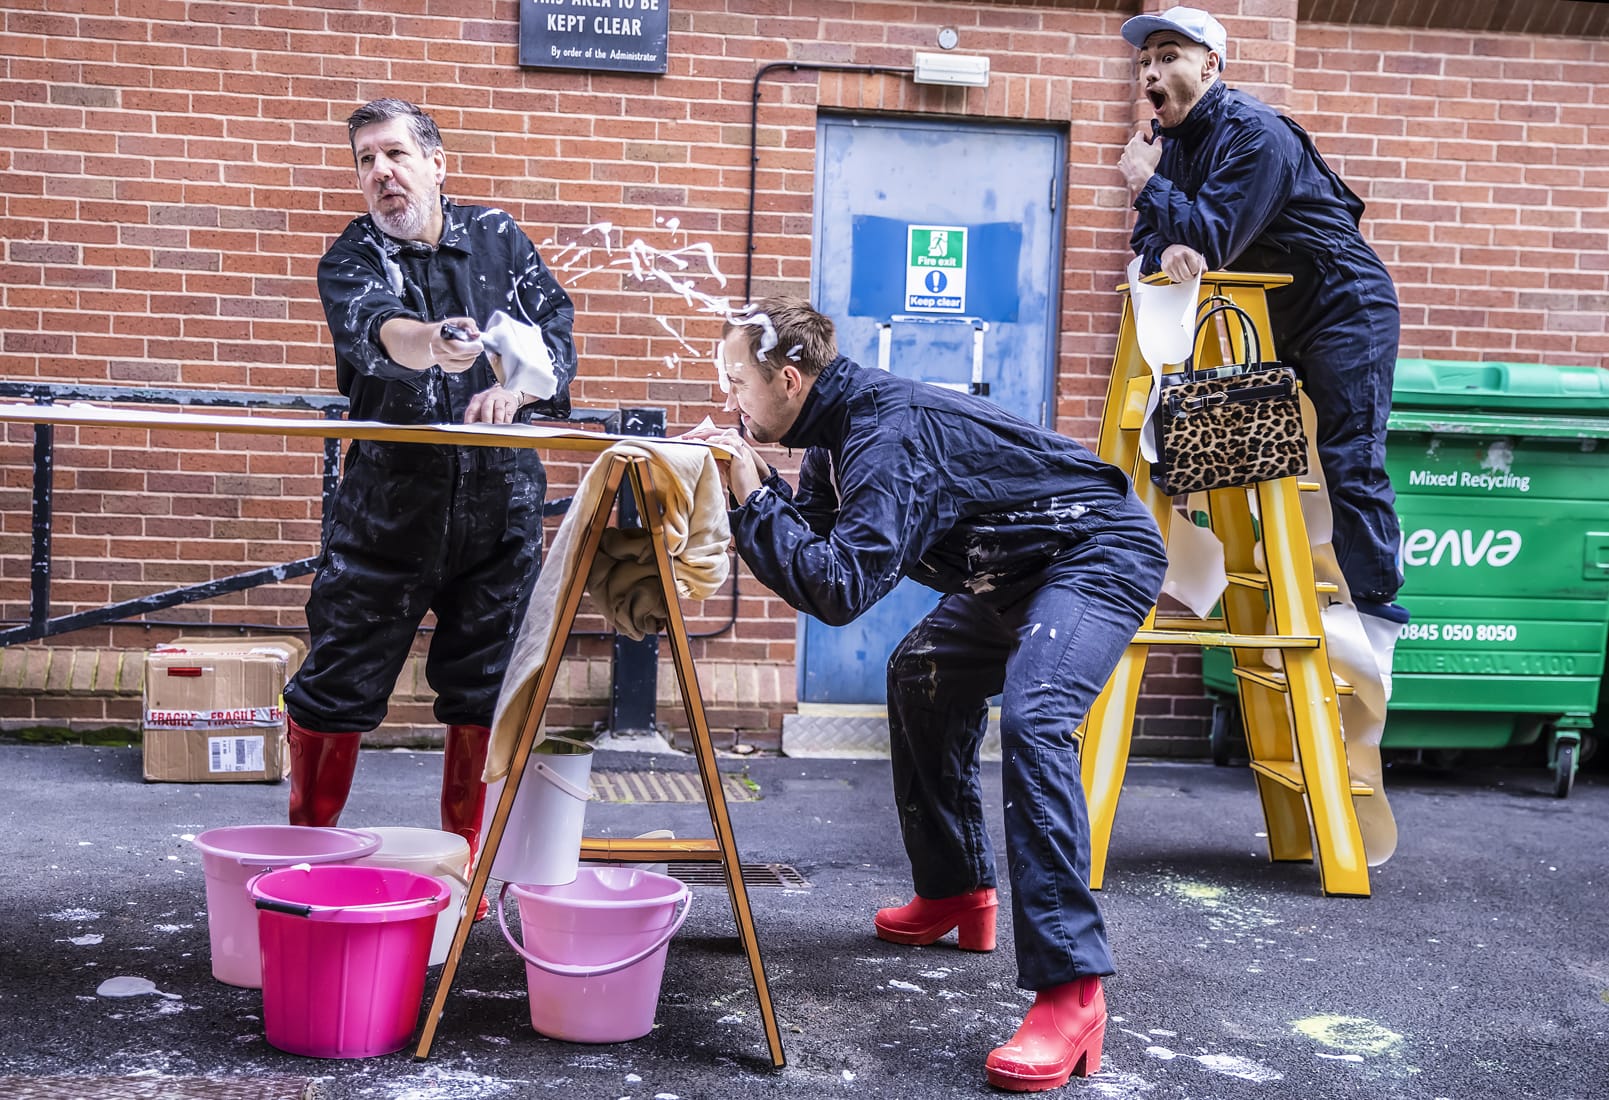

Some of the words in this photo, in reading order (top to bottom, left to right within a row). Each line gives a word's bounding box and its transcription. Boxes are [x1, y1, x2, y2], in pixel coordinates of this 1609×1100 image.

[548, 14, 586, 32] KEPT
[594, 17, 642, 36] CLEAR
[551, 45, 561, 58] By
[563, 47, 582, 58] order
[585, 48, 593, 58] of
[595, 49, 606, 59] the
[610, 49, 657, 61] Administrator
[917, 256, 937, 266] Fire
[938, 257, 957, 267] exit
[910, 296, 935, 308] Keep
[936, 297, 960, 307] clear
[1409, 470, 1458, 487] Mixed
[1461, 472, 1530, 491] Recycling
[1404, 529, 1522, 567] enva
[1400, 624, 1439, 640] 0845
[1442, 625, 1473, 641] 050
[1476, 625, 1517, 642] 8050
[1520, 656, 1577, 676] 1100
